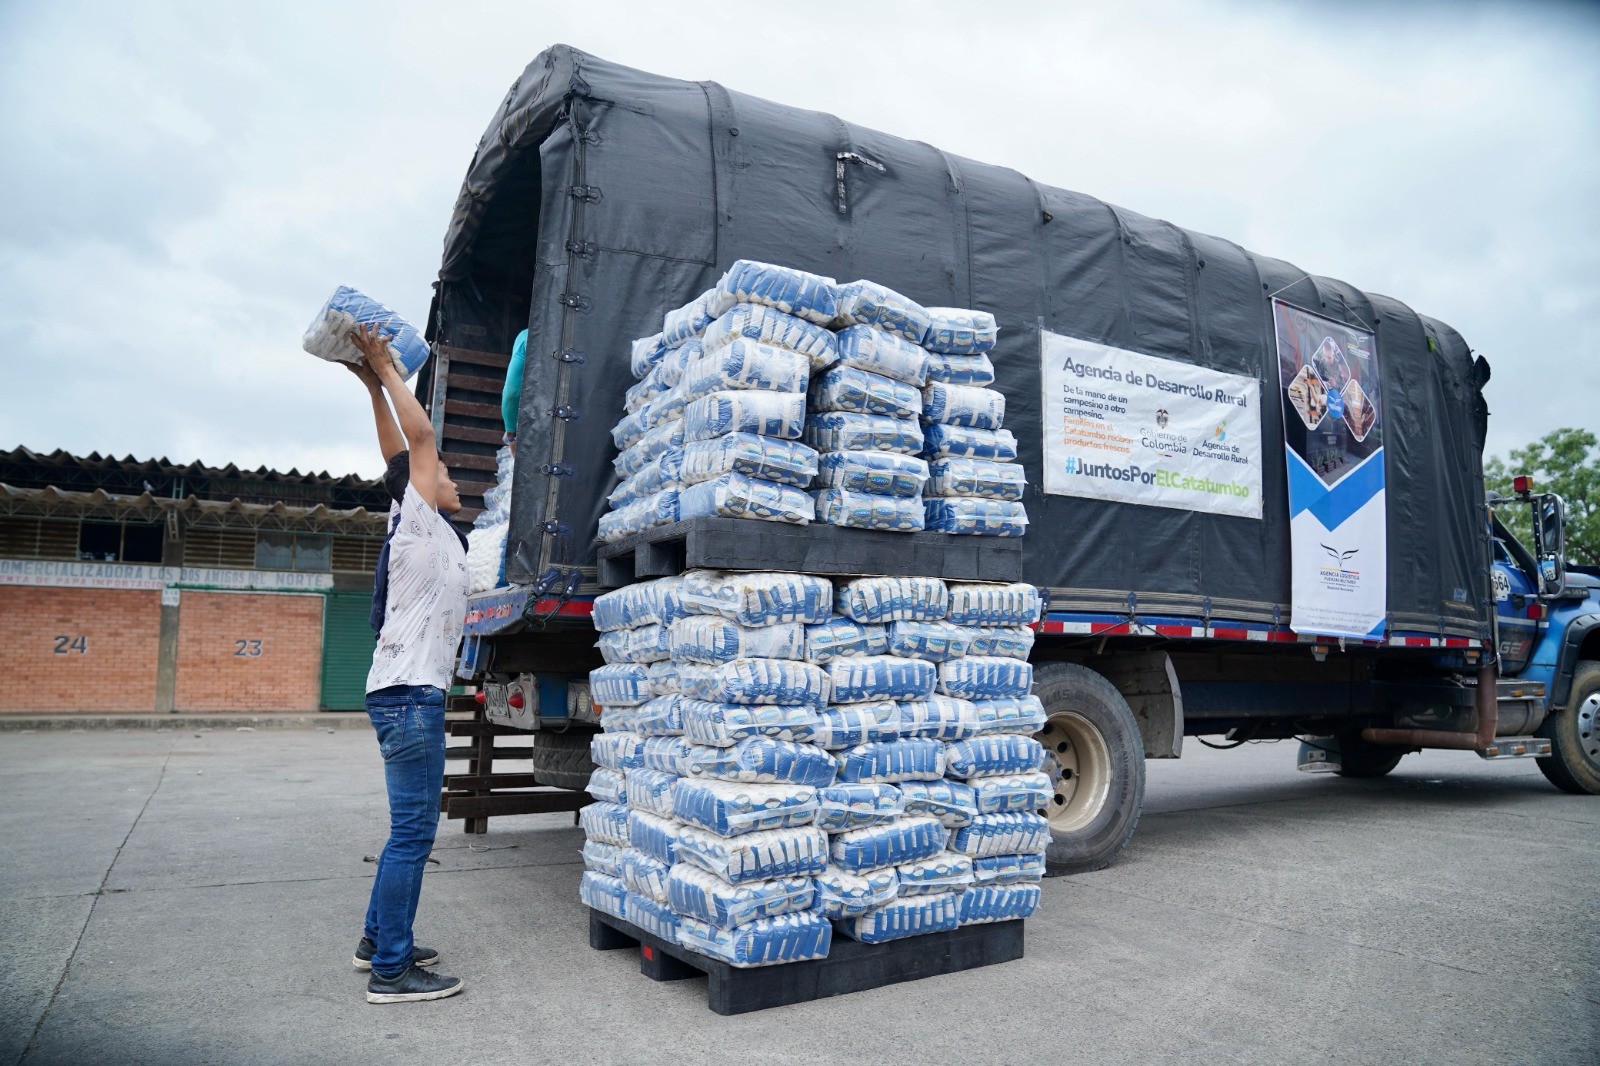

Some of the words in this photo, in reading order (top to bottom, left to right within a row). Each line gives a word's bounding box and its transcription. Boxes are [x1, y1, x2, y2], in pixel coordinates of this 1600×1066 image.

[1063, 357, 1122, 382] Agencia
[1125, 371, 1143, 386] de
[1145, 373, 1213, 401] Desarrollo
[1215, 389, 1247, 407] Rural
[1063, 384, 1074, 394] De
[1075, 387, 1083, 395] la
[1085, 390, 1106, 400] mano
[1108, 393, 1117, 402] de
[1118, 396, 1128, 404] un
[1063, 396, 1103, 410] campesino
[1110, 405, 1126, 414] otro
[1063, 407, 1104, 420] campesino.
[1063, 415, 1095, 428] Familias
[1095, 422, 1105, 430] en
[1106, 423, 1113, 431] el
[1063, 426, 1106, 440] Catatumbo
[1139, 427, 1176, 440] Gobierno
[1177, 433, 1187, 442] de
[1063, 437, 1103, 449] productos
[1103, 441, 1132, 453] frescos.
[1141, 437, 1187, 454] Colombia
[1202, 439, 1230, 452] Agencia
[1231, 444, 1240, 453] de
[1192, 447, 1230, 461] Desarrollo
[1230, 454, 1249, 464] Rural
[1065, 456, 1249, 498] #JuntosPorElCatatumbo
[0, 561, 143, 579] OMERCIALIZADORA
[148, 567, 174, 581] LOS
[180, 568, 200, 582] DOS
[204, 569, 244, 585] AMIGOS
[248, 571, 266, 585] DEL
[0, 574, 29, 584] ENTA
[56, 577, 88, 587] PAPA
[91, 578, 167, 589] IMPORTACIO
[53, 635, 87, 655] 24
[234, 639, 263, 657] 23
[1500, 641, 1522, 654] GE
